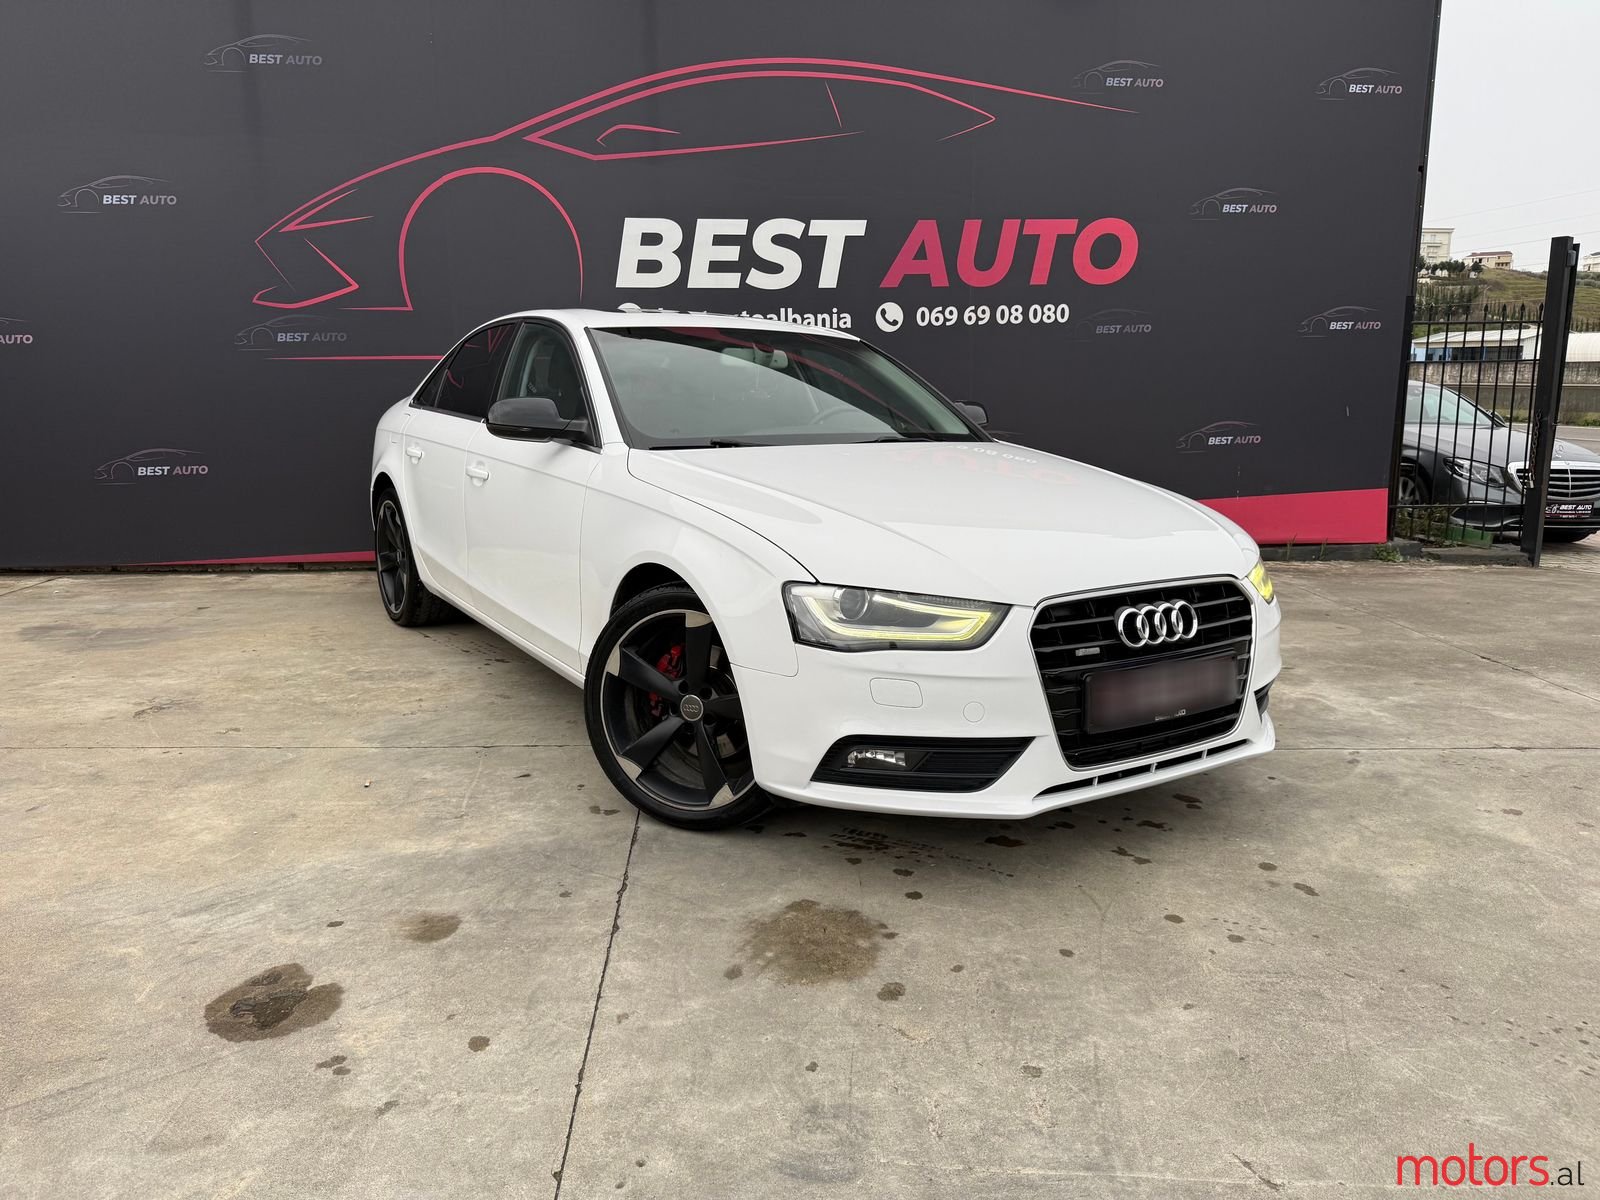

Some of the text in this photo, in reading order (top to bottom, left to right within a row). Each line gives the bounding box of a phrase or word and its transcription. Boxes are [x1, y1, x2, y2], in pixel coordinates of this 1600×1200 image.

[248, 53, 323, 65] BEST AUTO
[1105, 77, 1164, 88] BEST AUTO
[1348, 84, 1403, 94] BEST AUTO
[102, 194, 177, 205] BEST AUTO
[1222, 203, 1277, 213] BEST AUTO
[616, 218, 1139, 289] BEST AUTO
[917, 303, 1070, 326] 069 69 08 080
[1095, 324, 1152, 334] BEST AUTO
[1329, 321, 1381, 331] BEST AUTO
[277, 332, 347, 343] BEST AUTO
[1207, 435, 1262, 446] BEST AUTO
[137, 465, 208, 476] BEST AUTO
